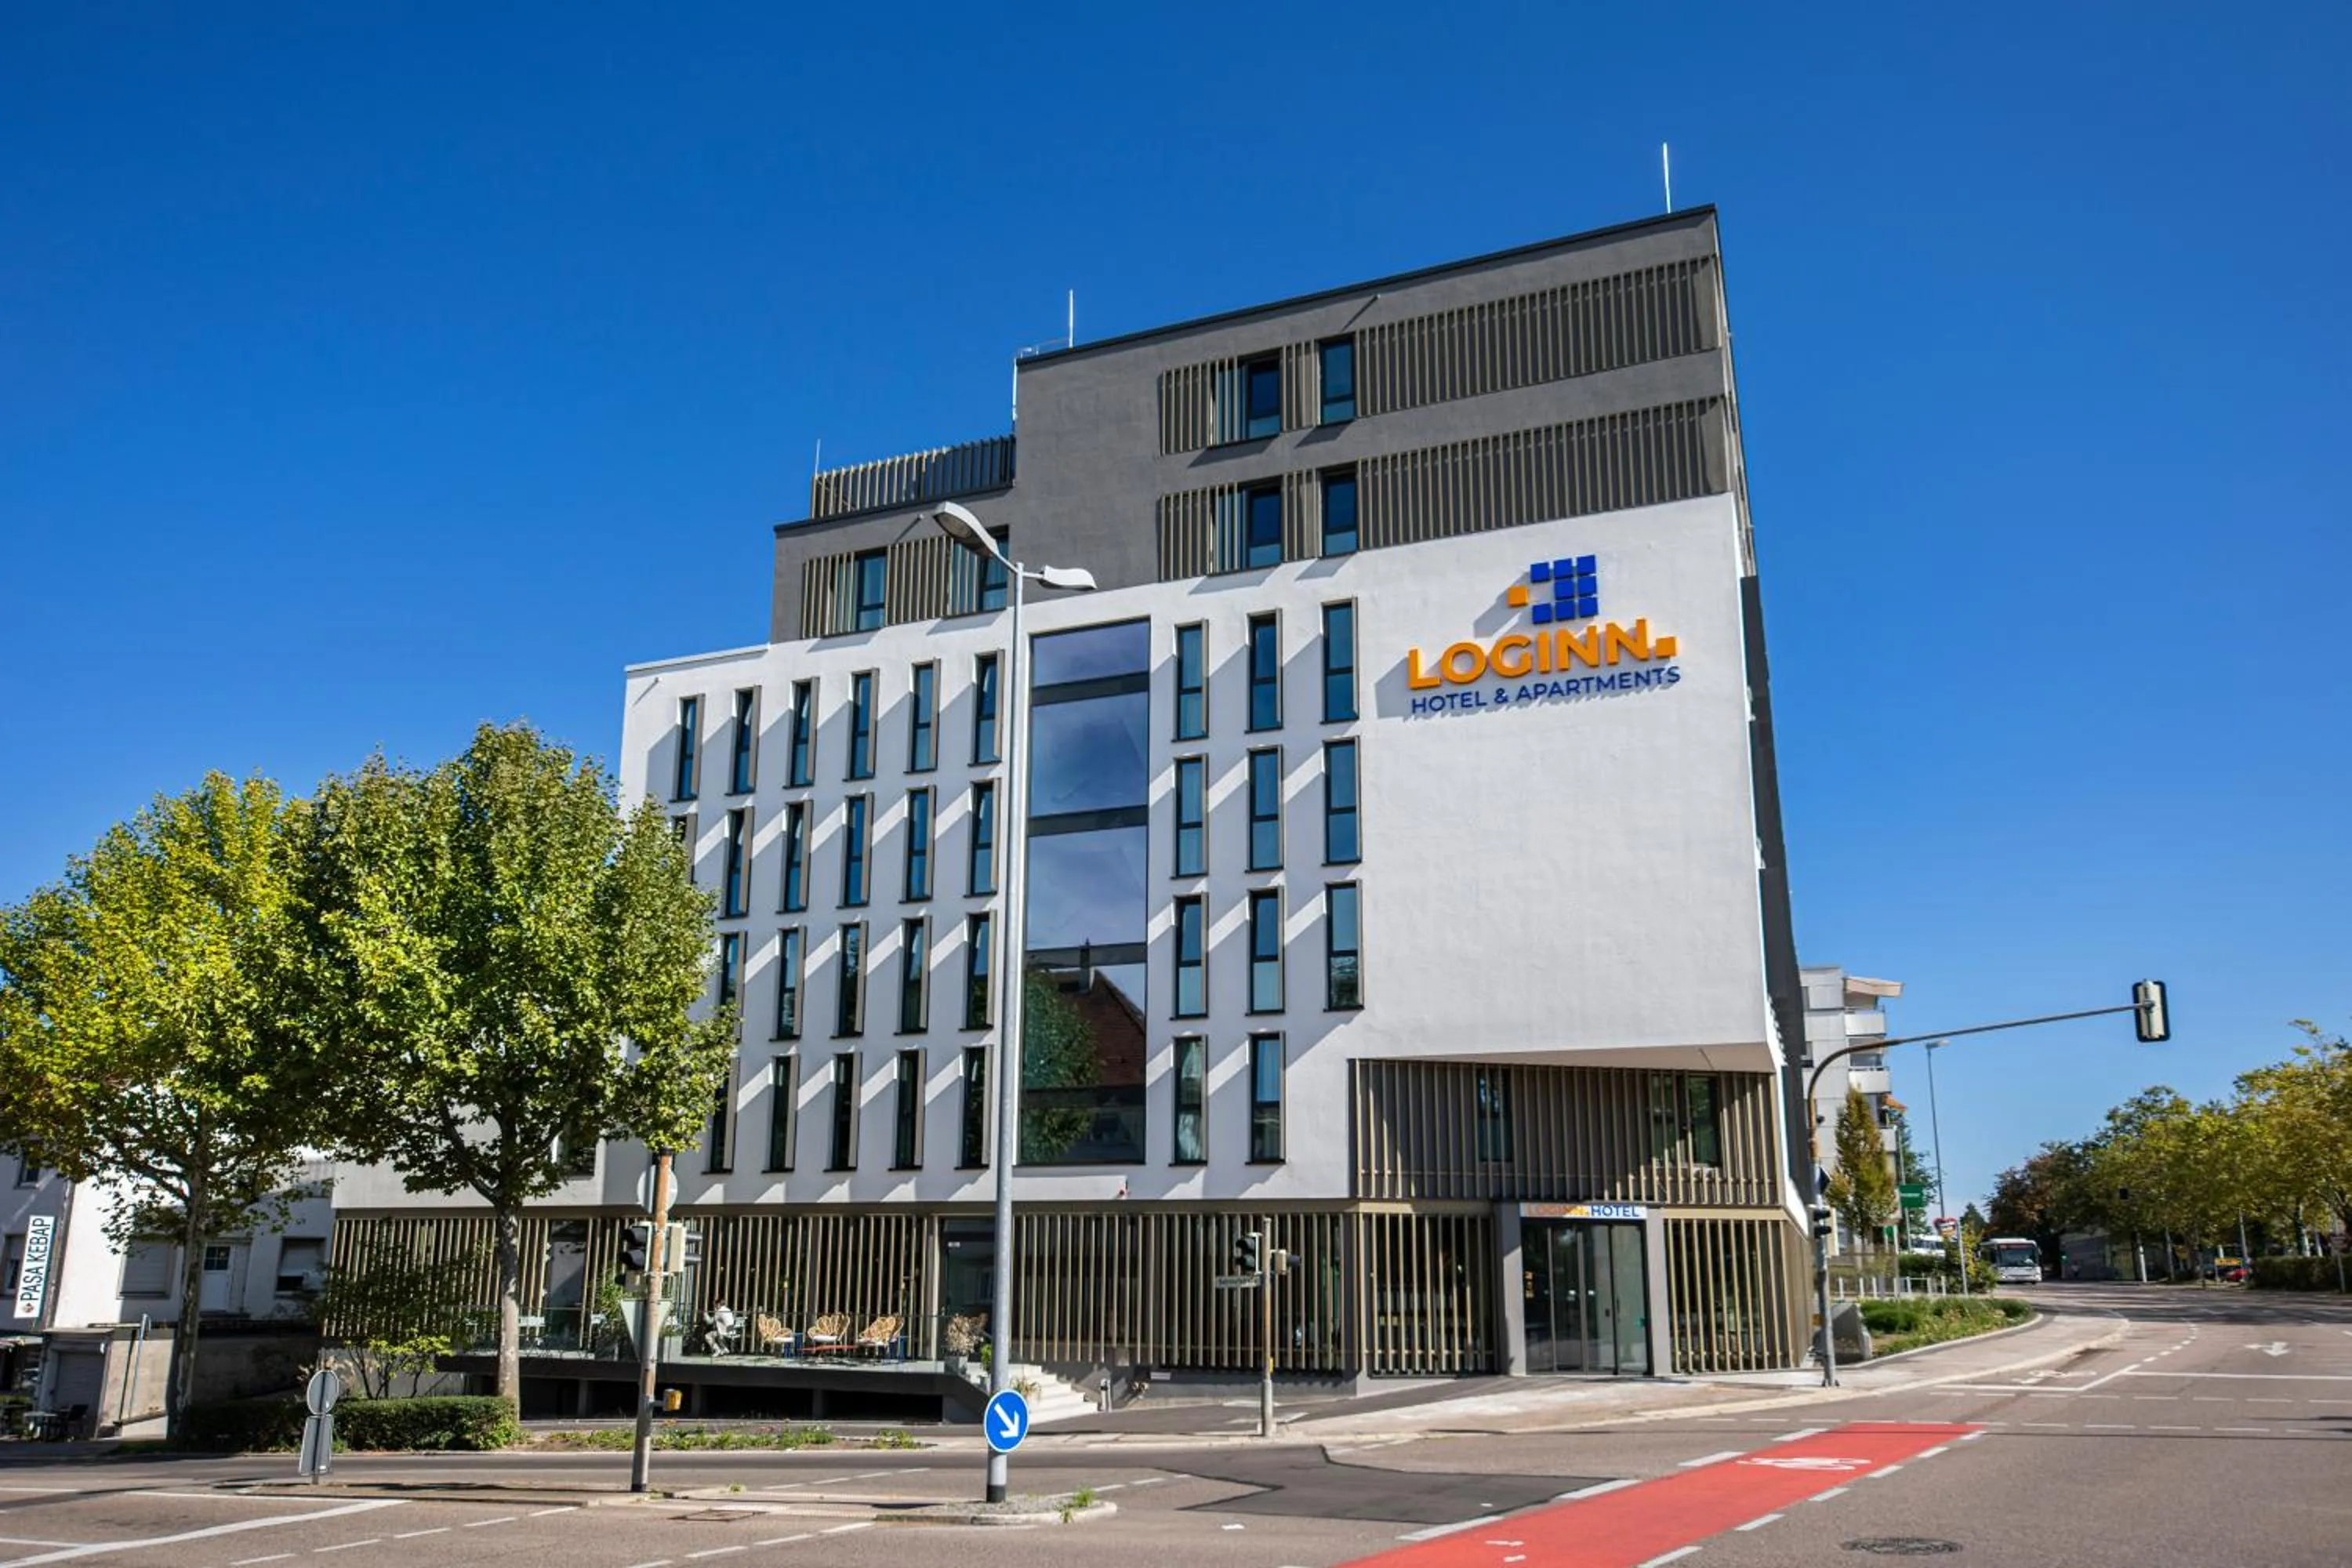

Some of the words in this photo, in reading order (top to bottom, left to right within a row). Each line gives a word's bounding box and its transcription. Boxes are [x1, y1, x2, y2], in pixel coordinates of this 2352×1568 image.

[1411, 692, 1487, 714] HOTEL
[1494, 688, 1509, 704] &
[1515, 666, 1681, 702] APARTMENTS
[1591, 1204, 1639, 1218] HOTEL
[26, 1218, 51, 1263] KEBAP
[20, 1265, 44, 1301] PASA
